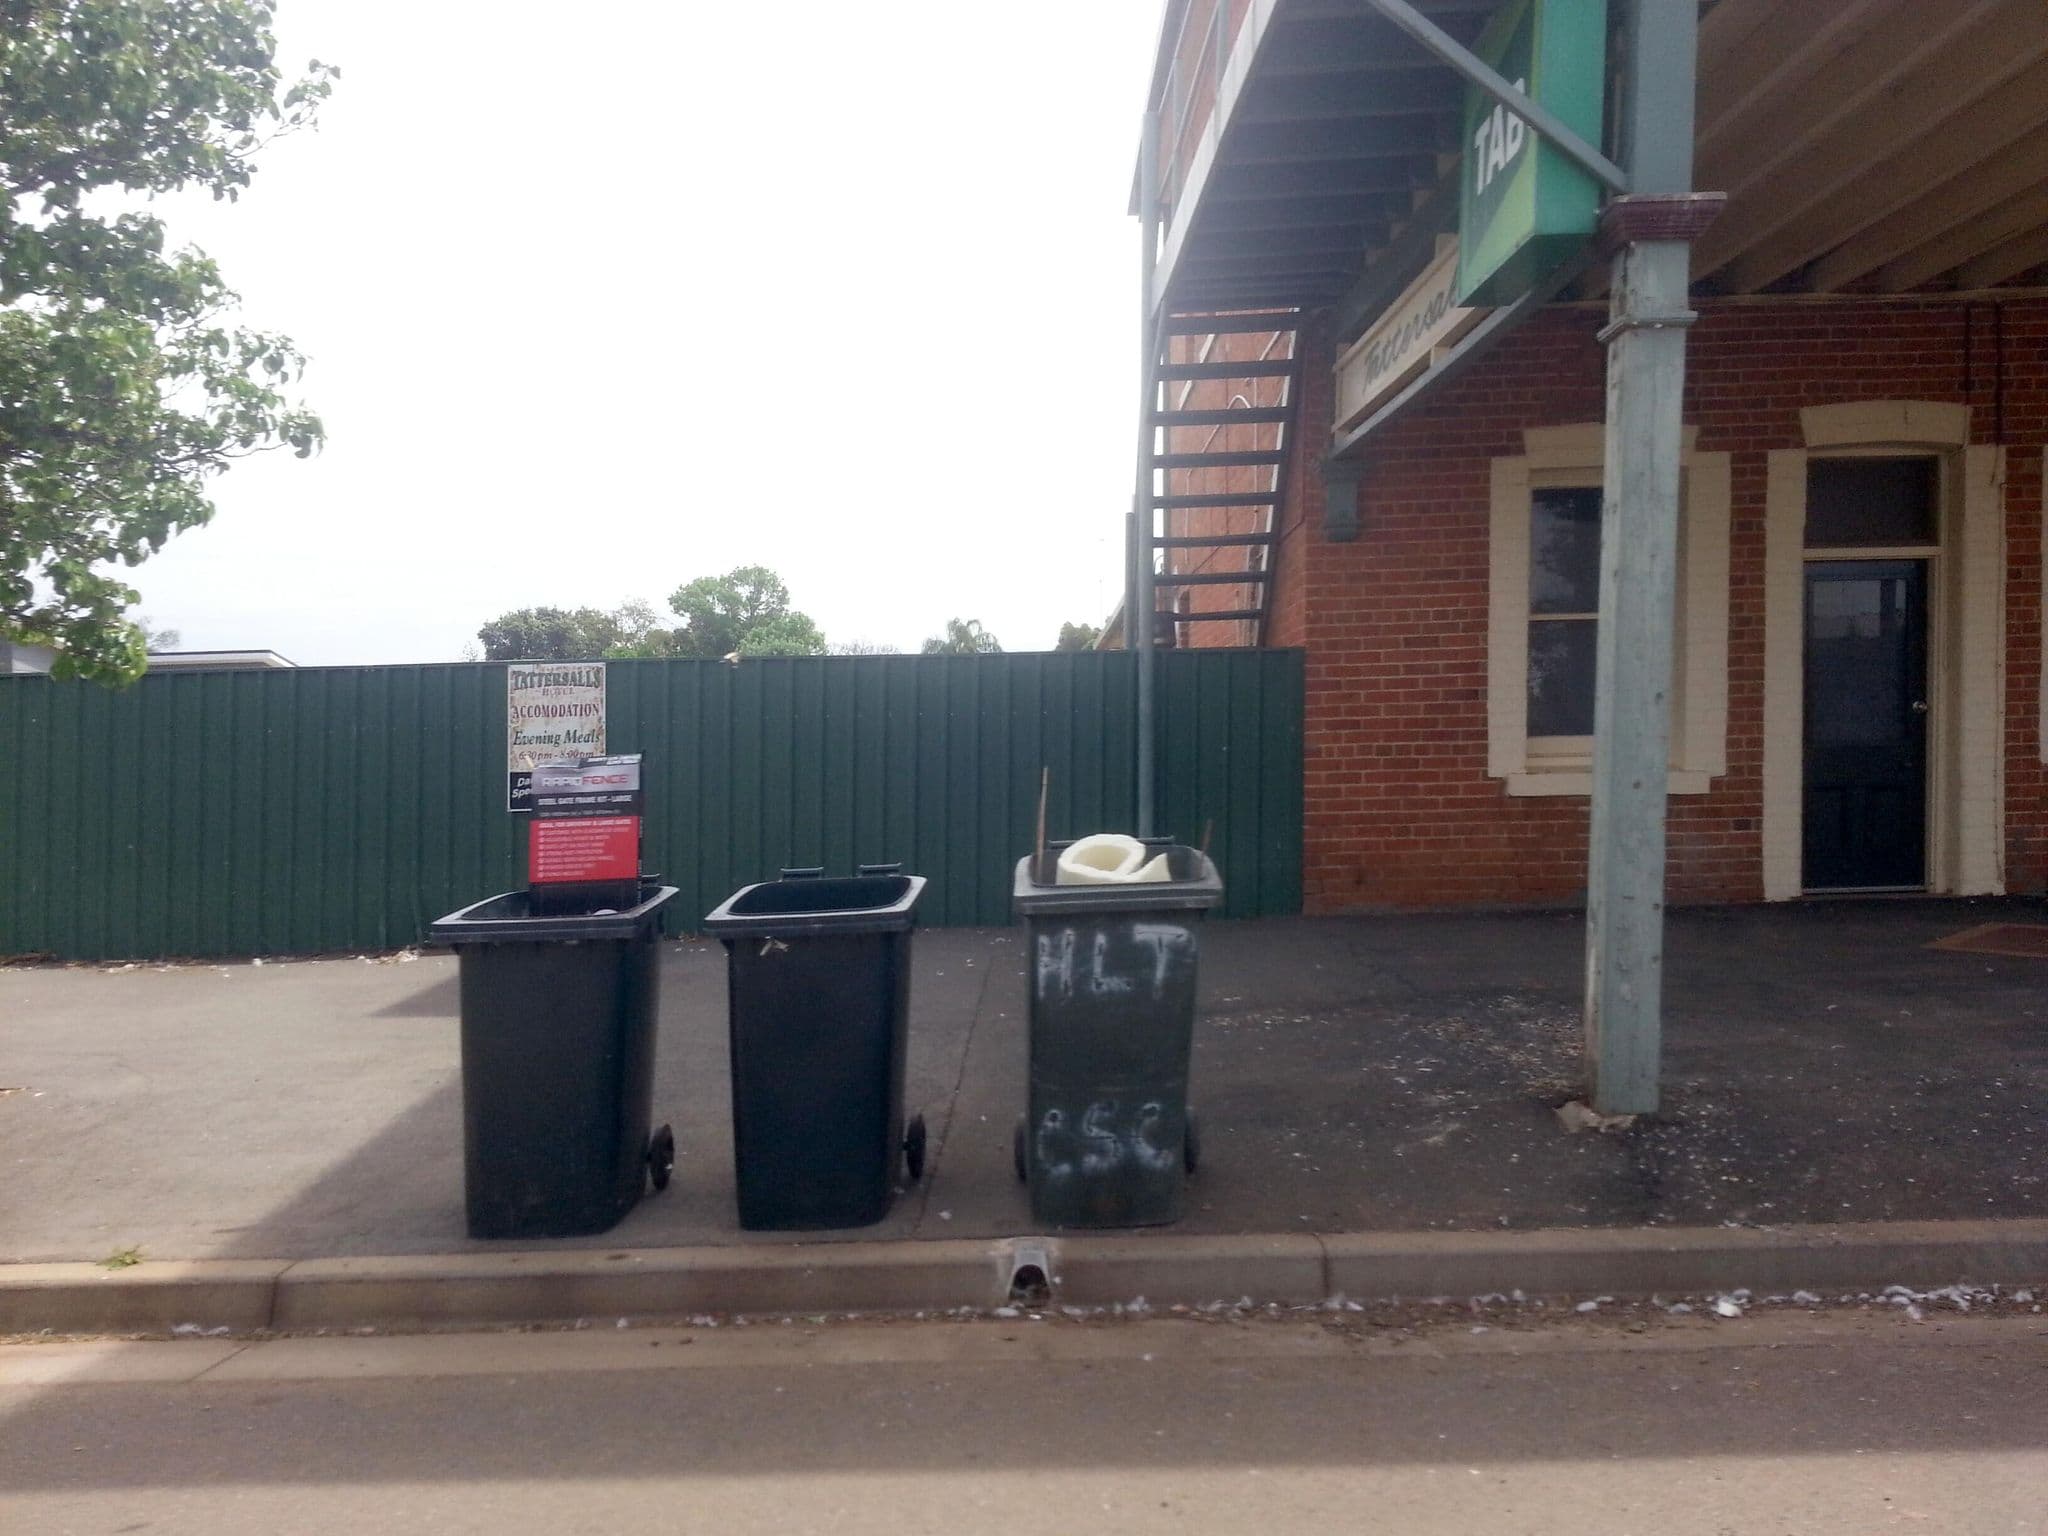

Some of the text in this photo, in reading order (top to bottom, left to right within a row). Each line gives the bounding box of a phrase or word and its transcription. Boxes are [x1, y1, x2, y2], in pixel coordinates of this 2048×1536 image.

[512, 667, 600, 690] TATTERSALLS
[511, 703, 600, 718] ACCOMODATION
[513, 729, 600, 747] Evening Meals
